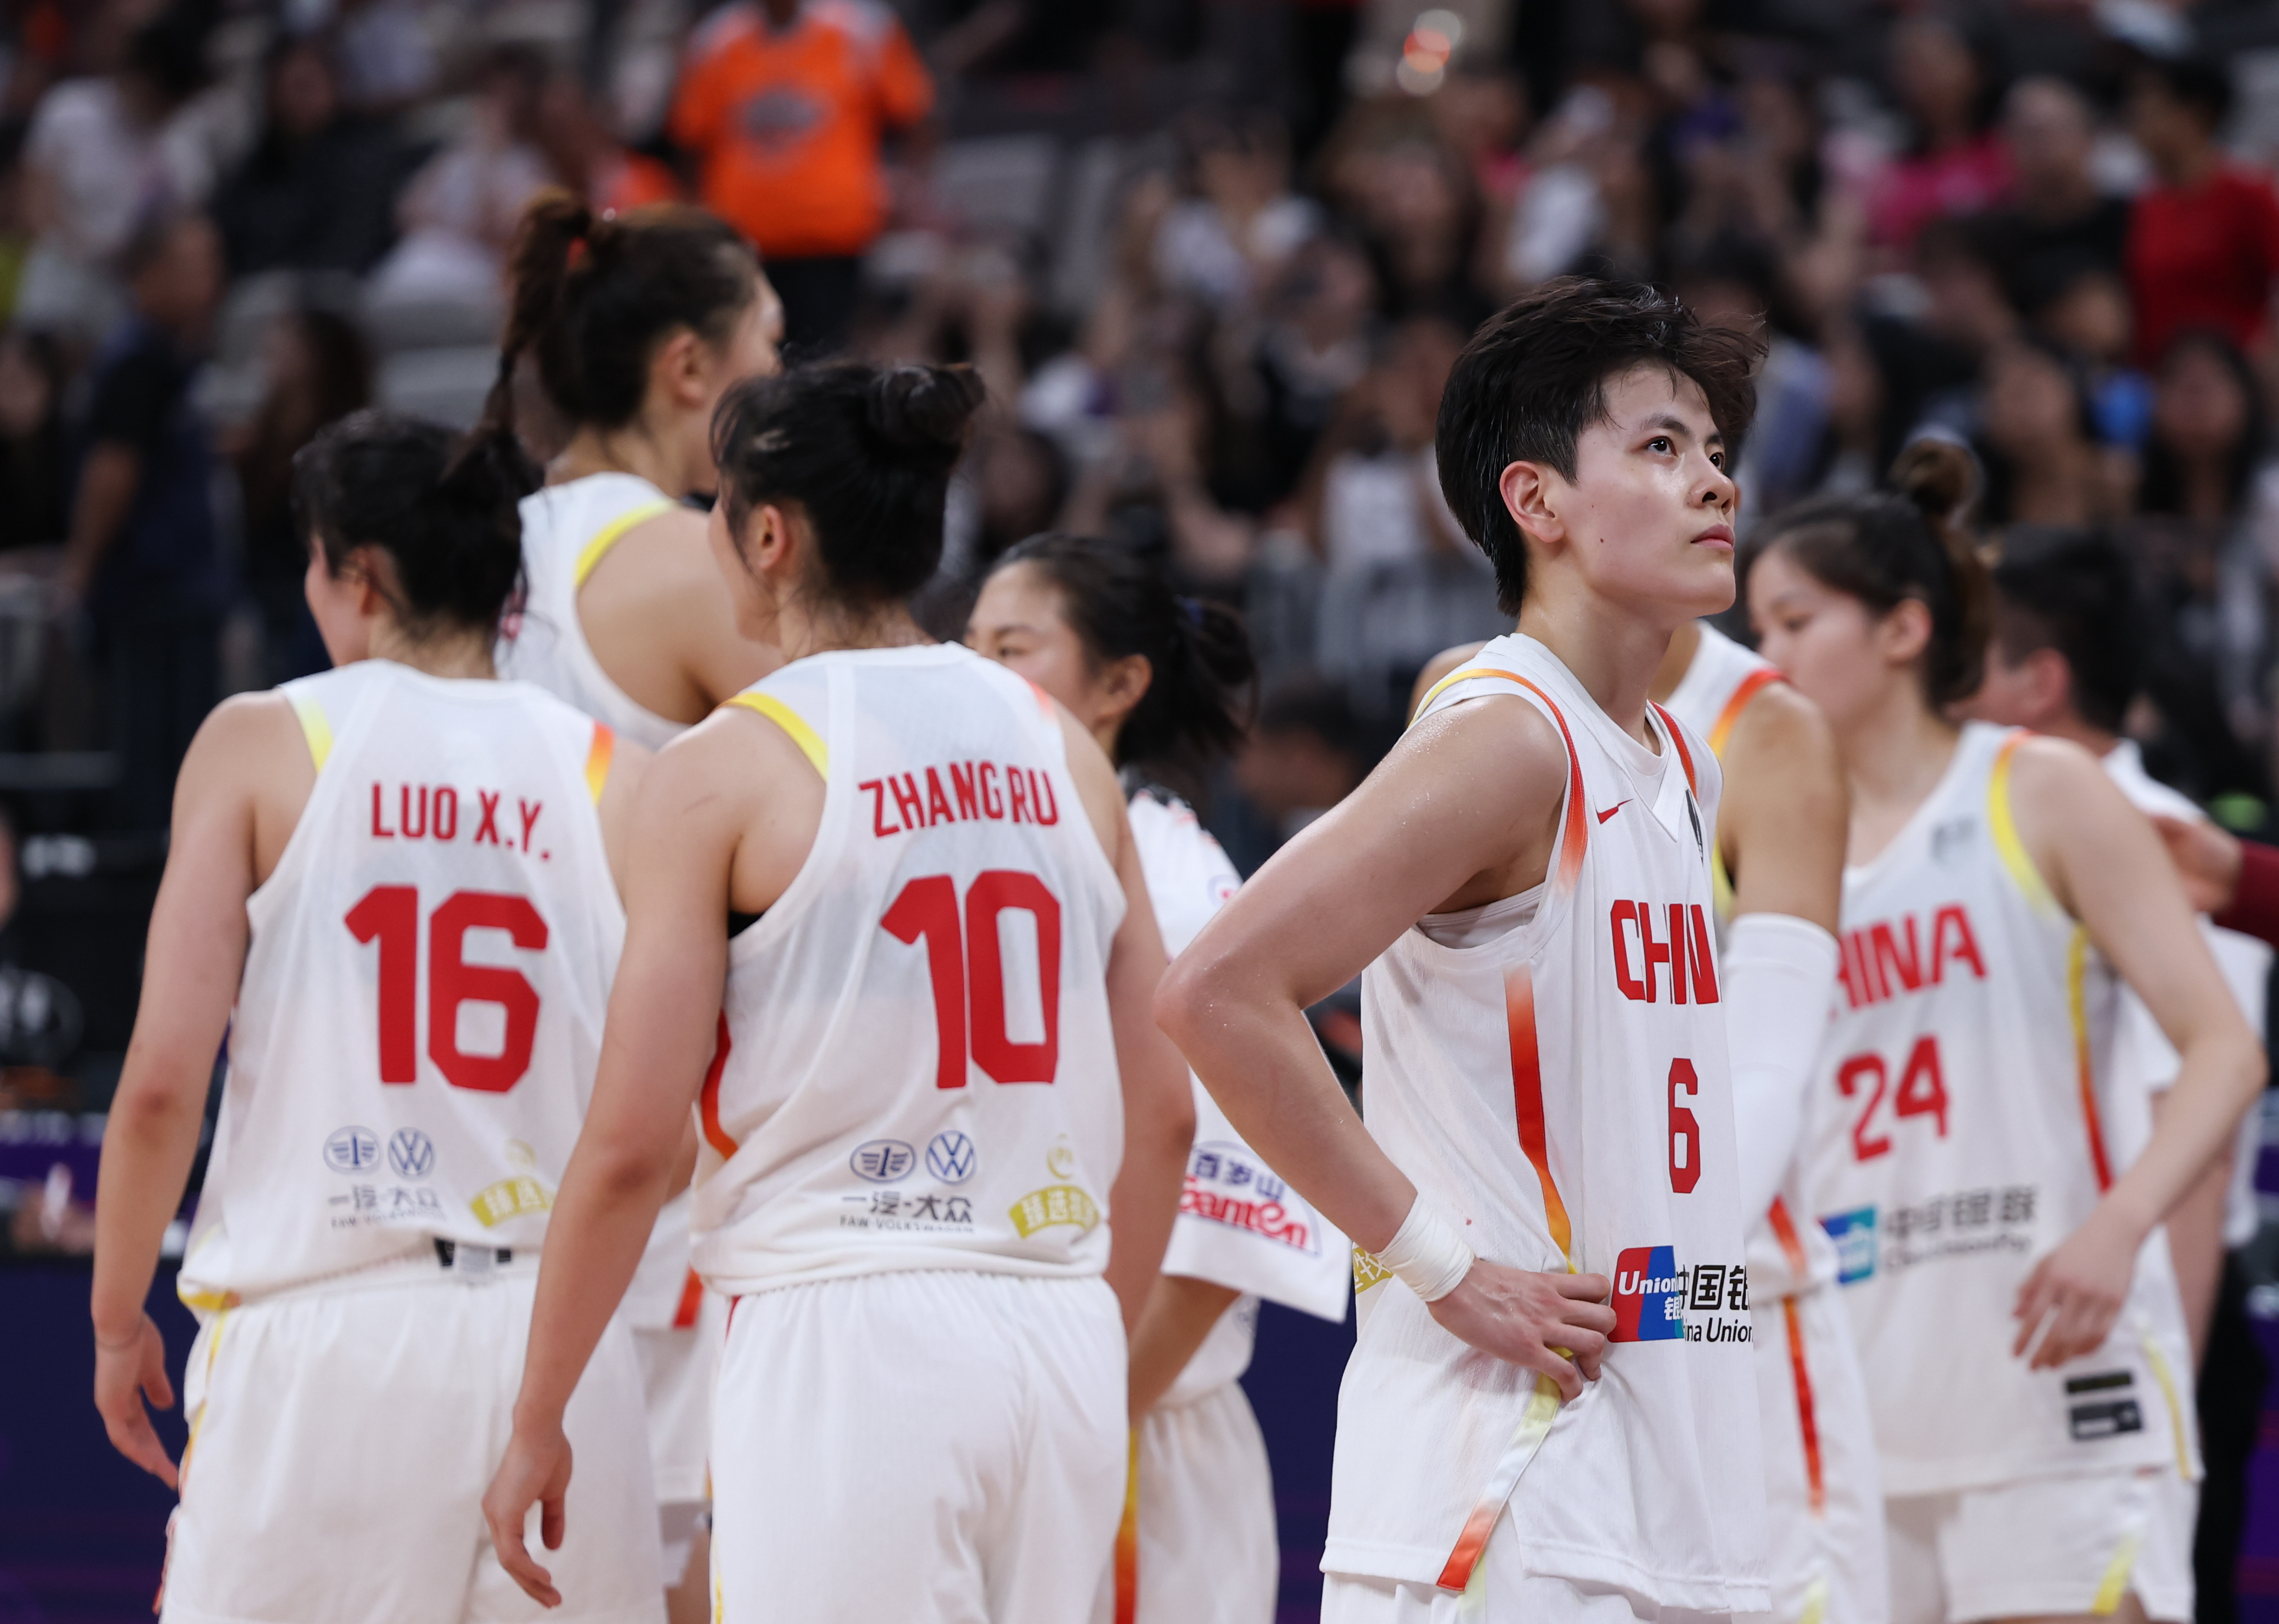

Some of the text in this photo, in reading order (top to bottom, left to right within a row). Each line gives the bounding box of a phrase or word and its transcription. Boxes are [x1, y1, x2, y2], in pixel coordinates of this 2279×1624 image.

[371, 783, 551, 861] LUO X.Y.
[343, 884, 549, 1094] 16
[879, 869, 1062, 1091] 10
[1610, 899, 1723, 1005] CHIN
[1667, 1057, 1703, 1195] 6
[1835, 1034, 1951, 1163] 24
